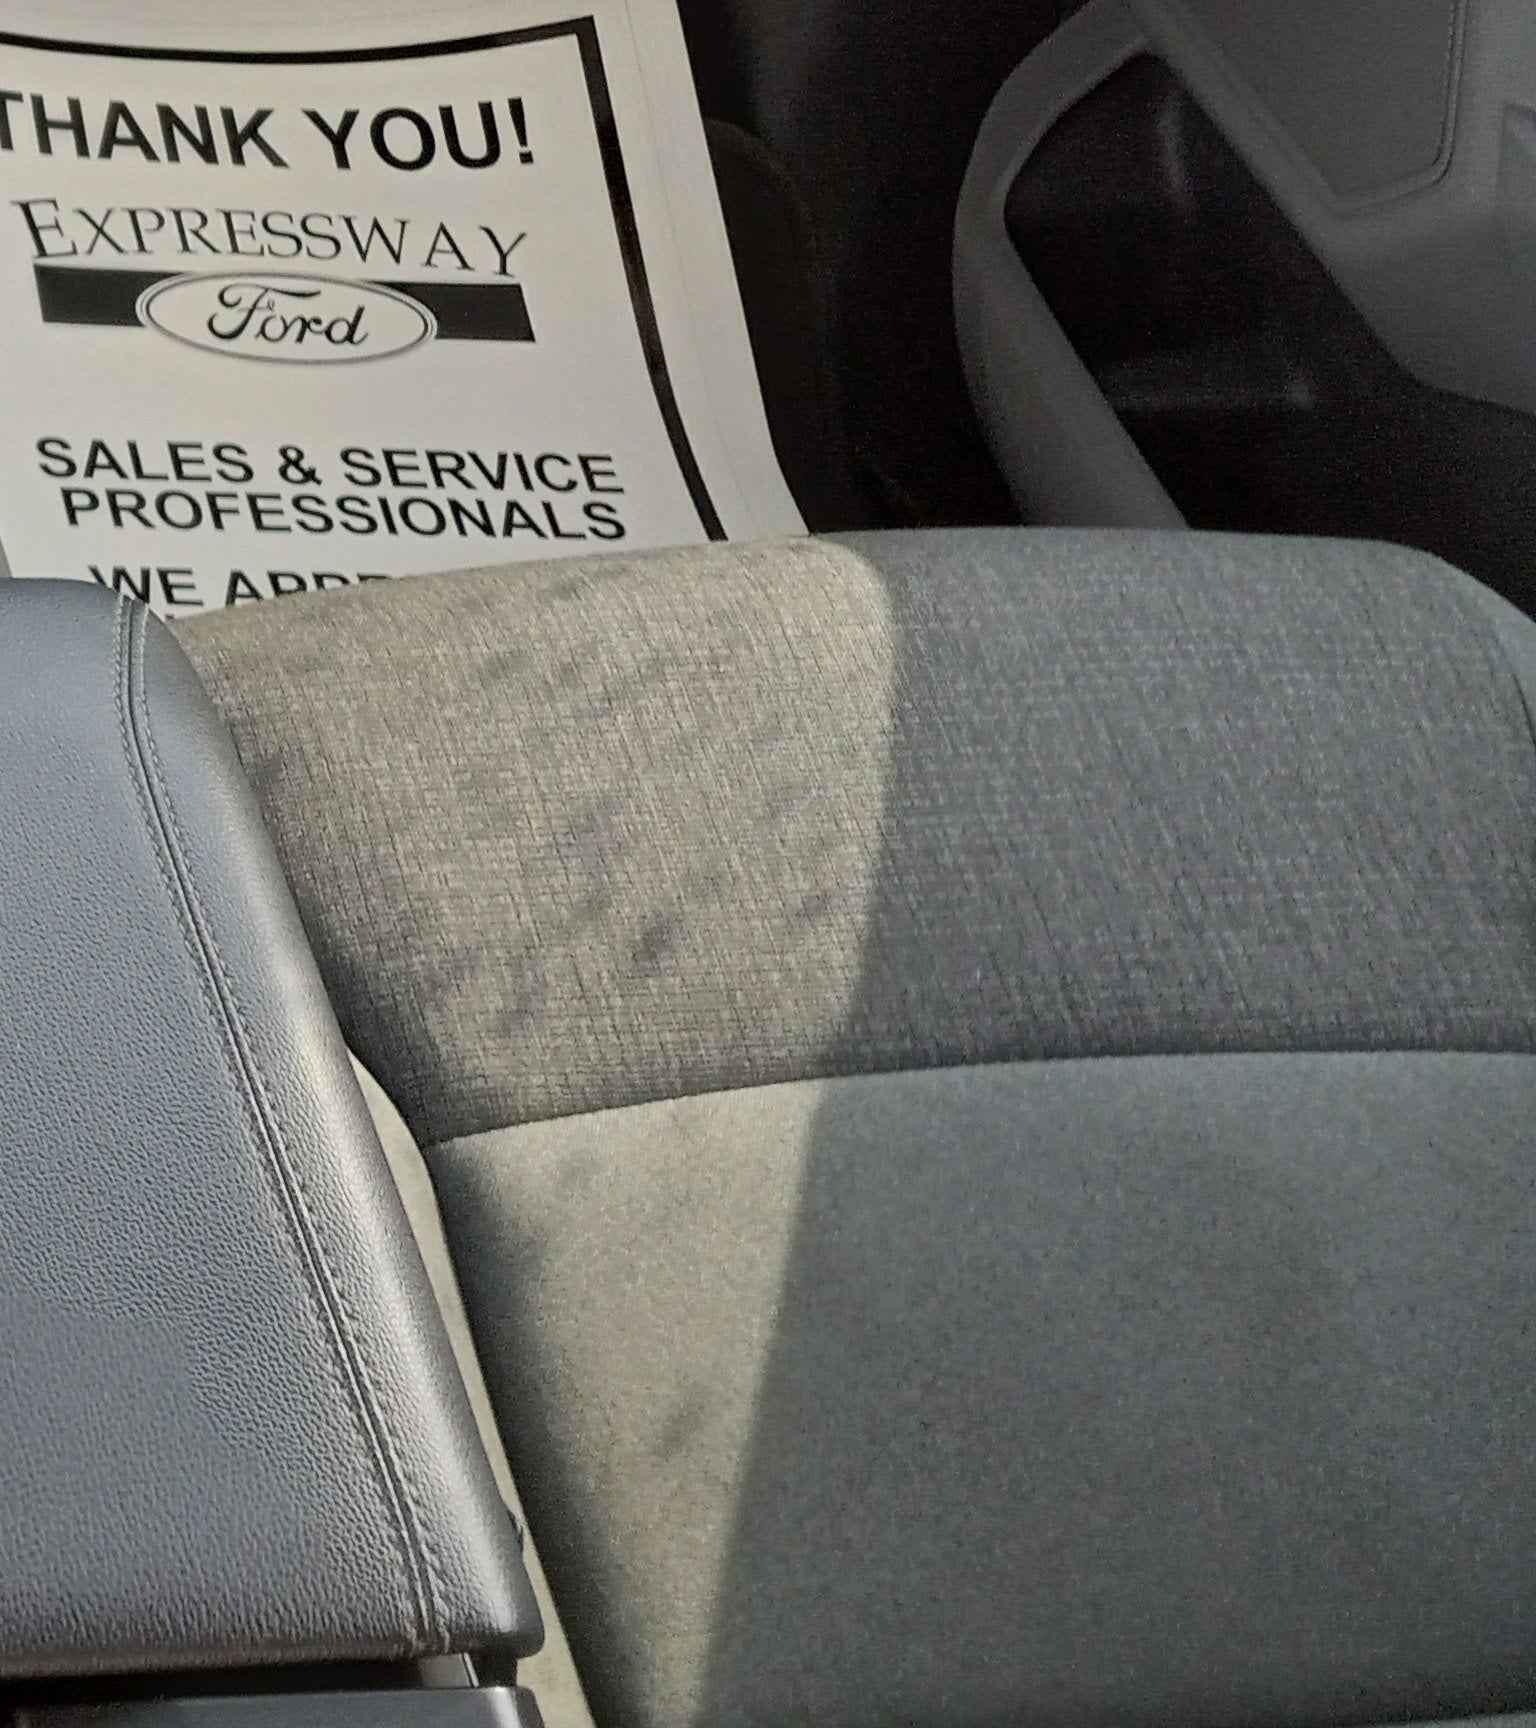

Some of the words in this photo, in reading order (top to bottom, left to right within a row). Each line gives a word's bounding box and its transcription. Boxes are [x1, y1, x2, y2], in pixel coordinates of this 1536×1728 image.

[304, 96, 535, 172] YOU!
[11, 198, 528, 277] EXPRESSWAY
[205, 283, 369, 349] Ford
[35, 435, 254, 484] SALES
[279, 444, 323, 485] &
[339, 446, 626, 496] SERVICE
[61, 487, 628, 542] PROFESSIONALS
[88, 565, 204, 606] WE
